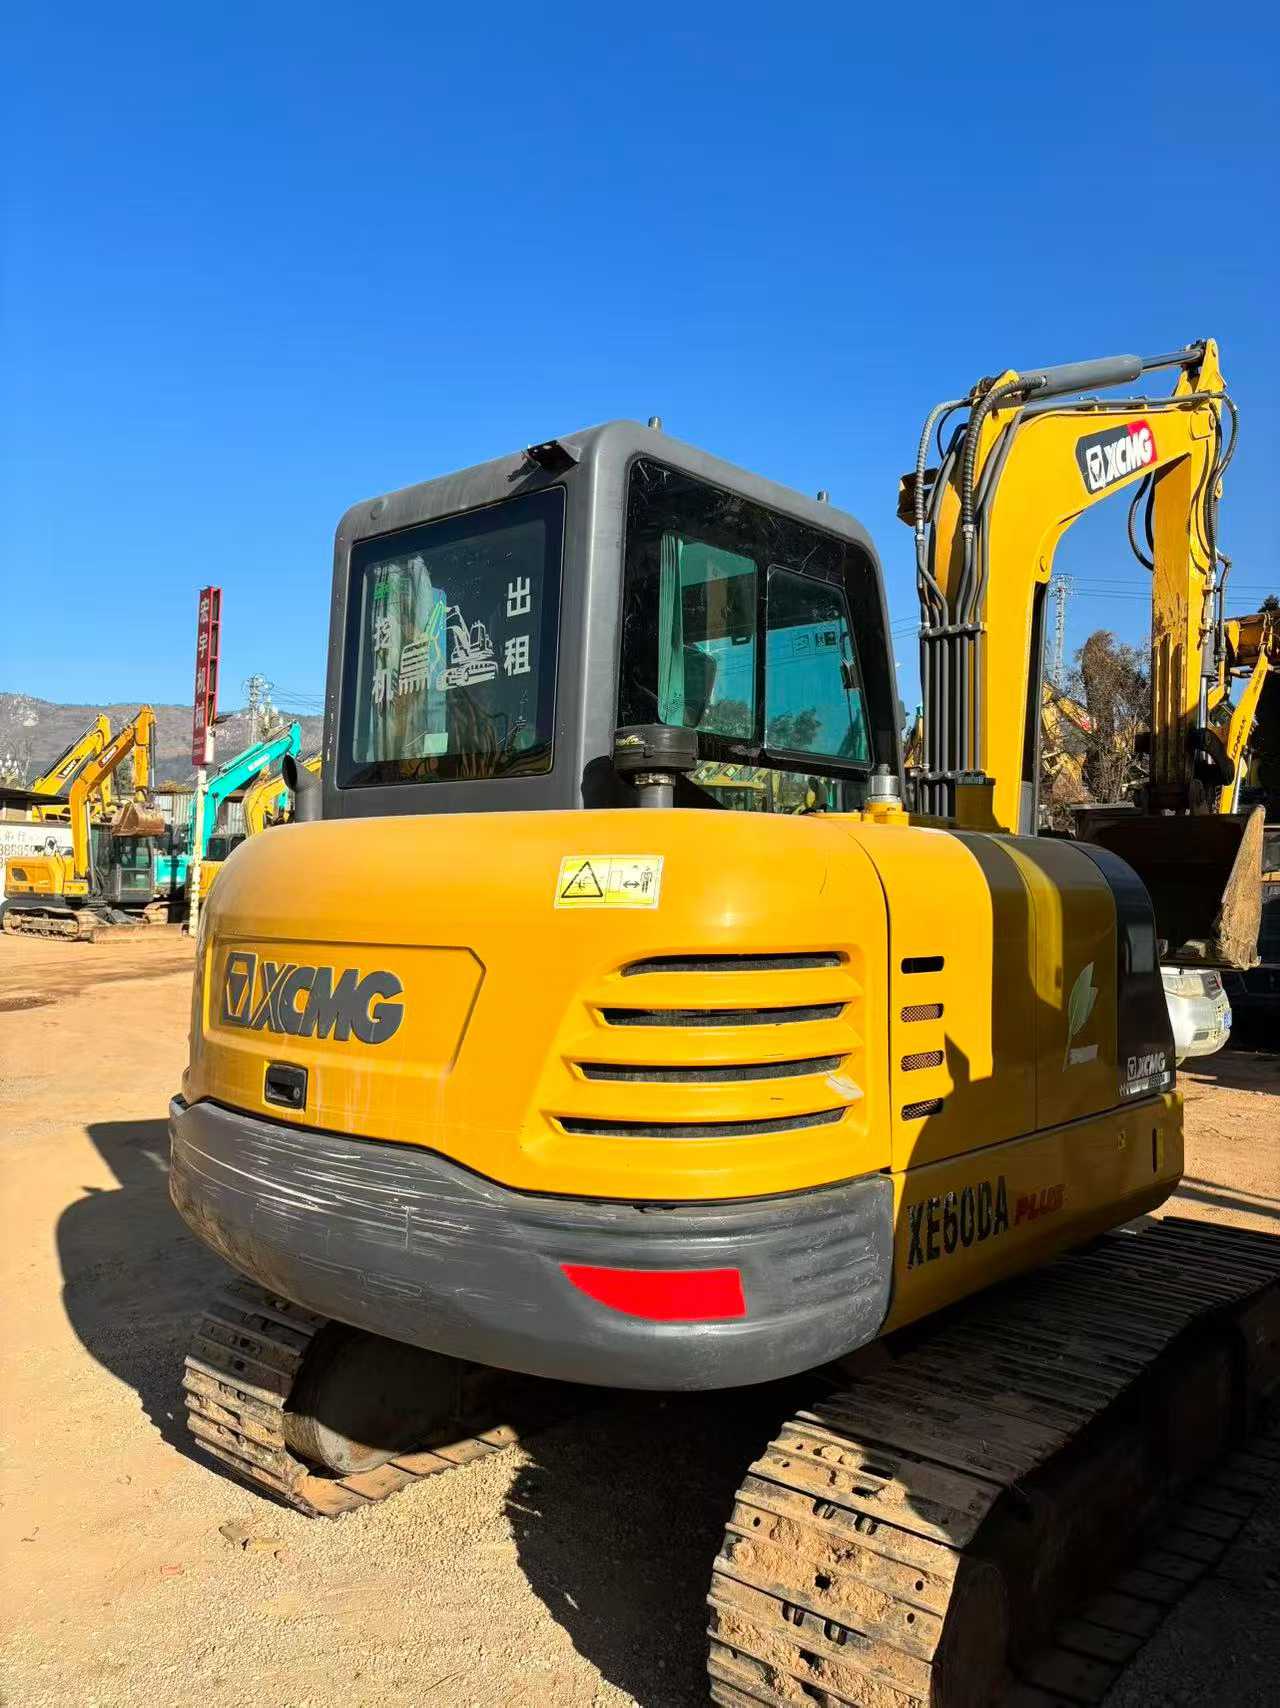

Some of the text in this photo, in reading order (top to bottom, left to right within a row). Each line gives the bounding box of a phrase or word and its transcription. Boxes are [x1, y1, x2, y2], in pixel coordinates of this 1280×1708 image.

[1103, 427, 1153, 482] XCMG
[371, 615, 394, 704] 挖机
[503, 575, 532, 677] 出租
[253, 961, 405, 1045] XCMG
[1136, 1052, 1166, 1078] XCMG
[906, 1175, 1009, 1270] XE60DA
